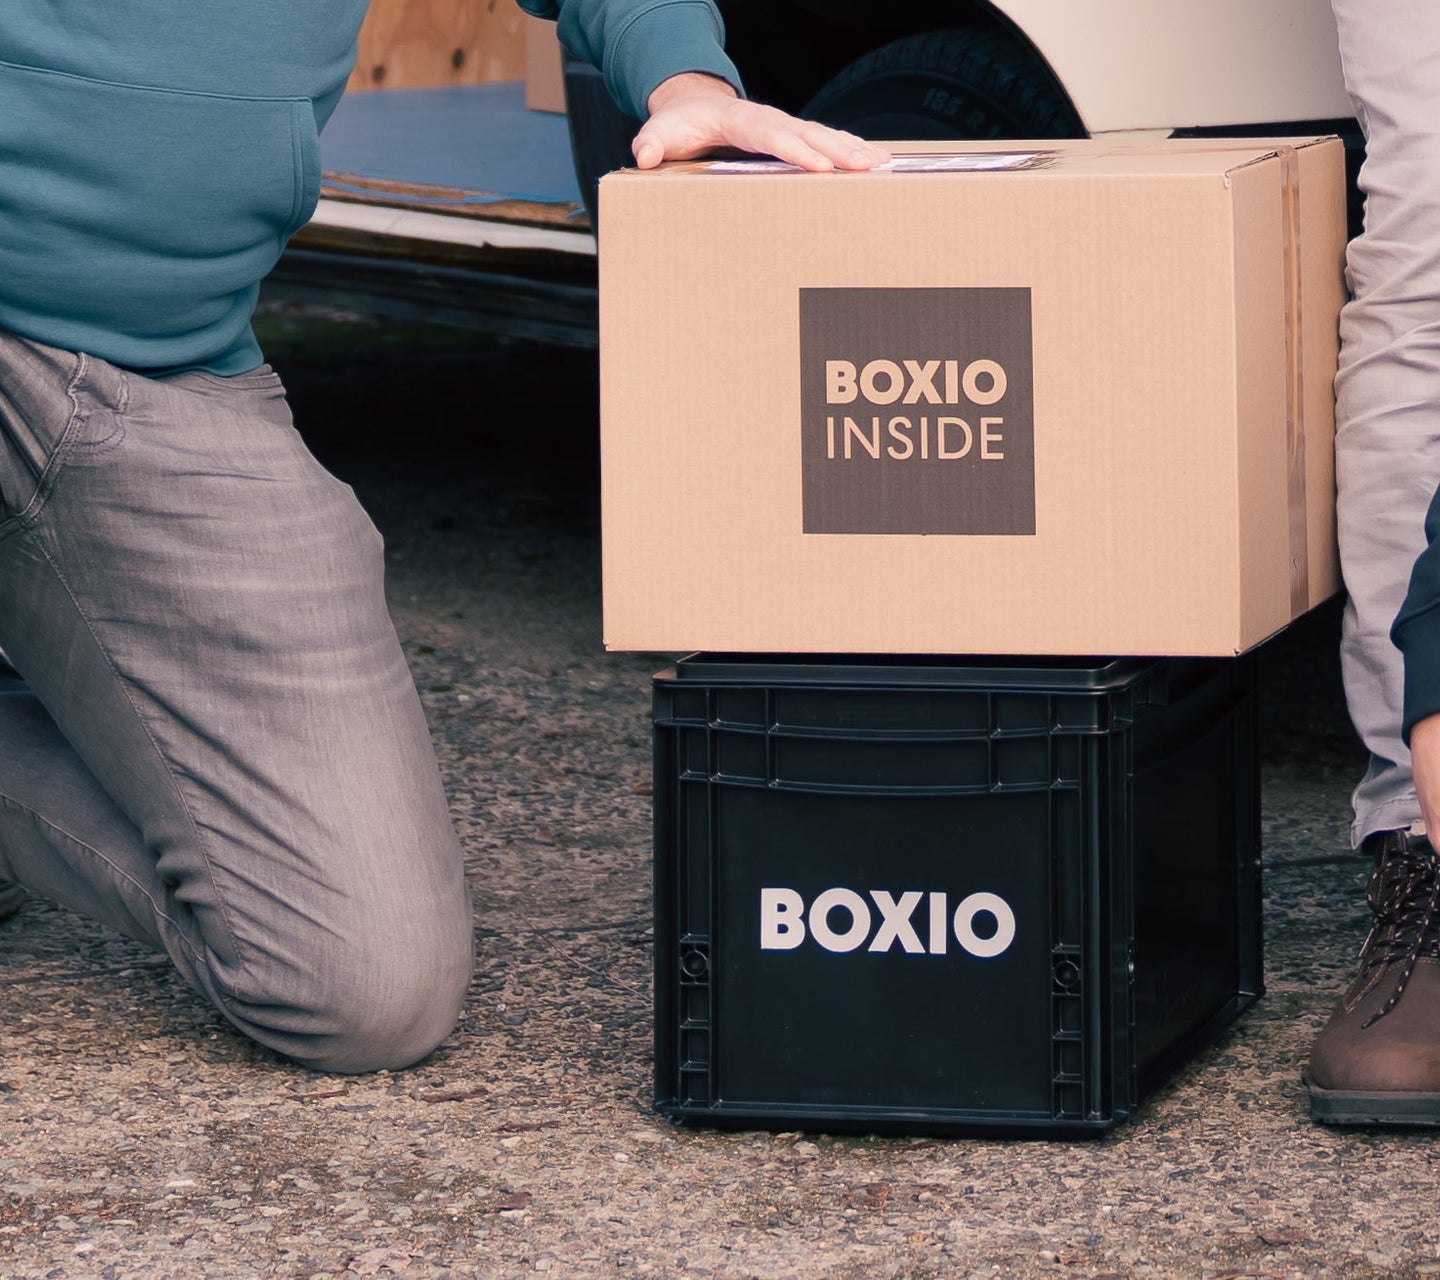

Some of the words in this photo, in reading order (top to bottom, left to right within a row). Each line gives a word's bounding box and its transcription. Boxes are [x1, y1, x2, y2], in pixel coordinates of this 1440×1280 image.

[826, 359, 1008, 406] BOXIO
[827, 416, 1005, 460] INSIDE
[760, 887, 1016, 958] BOXIO
